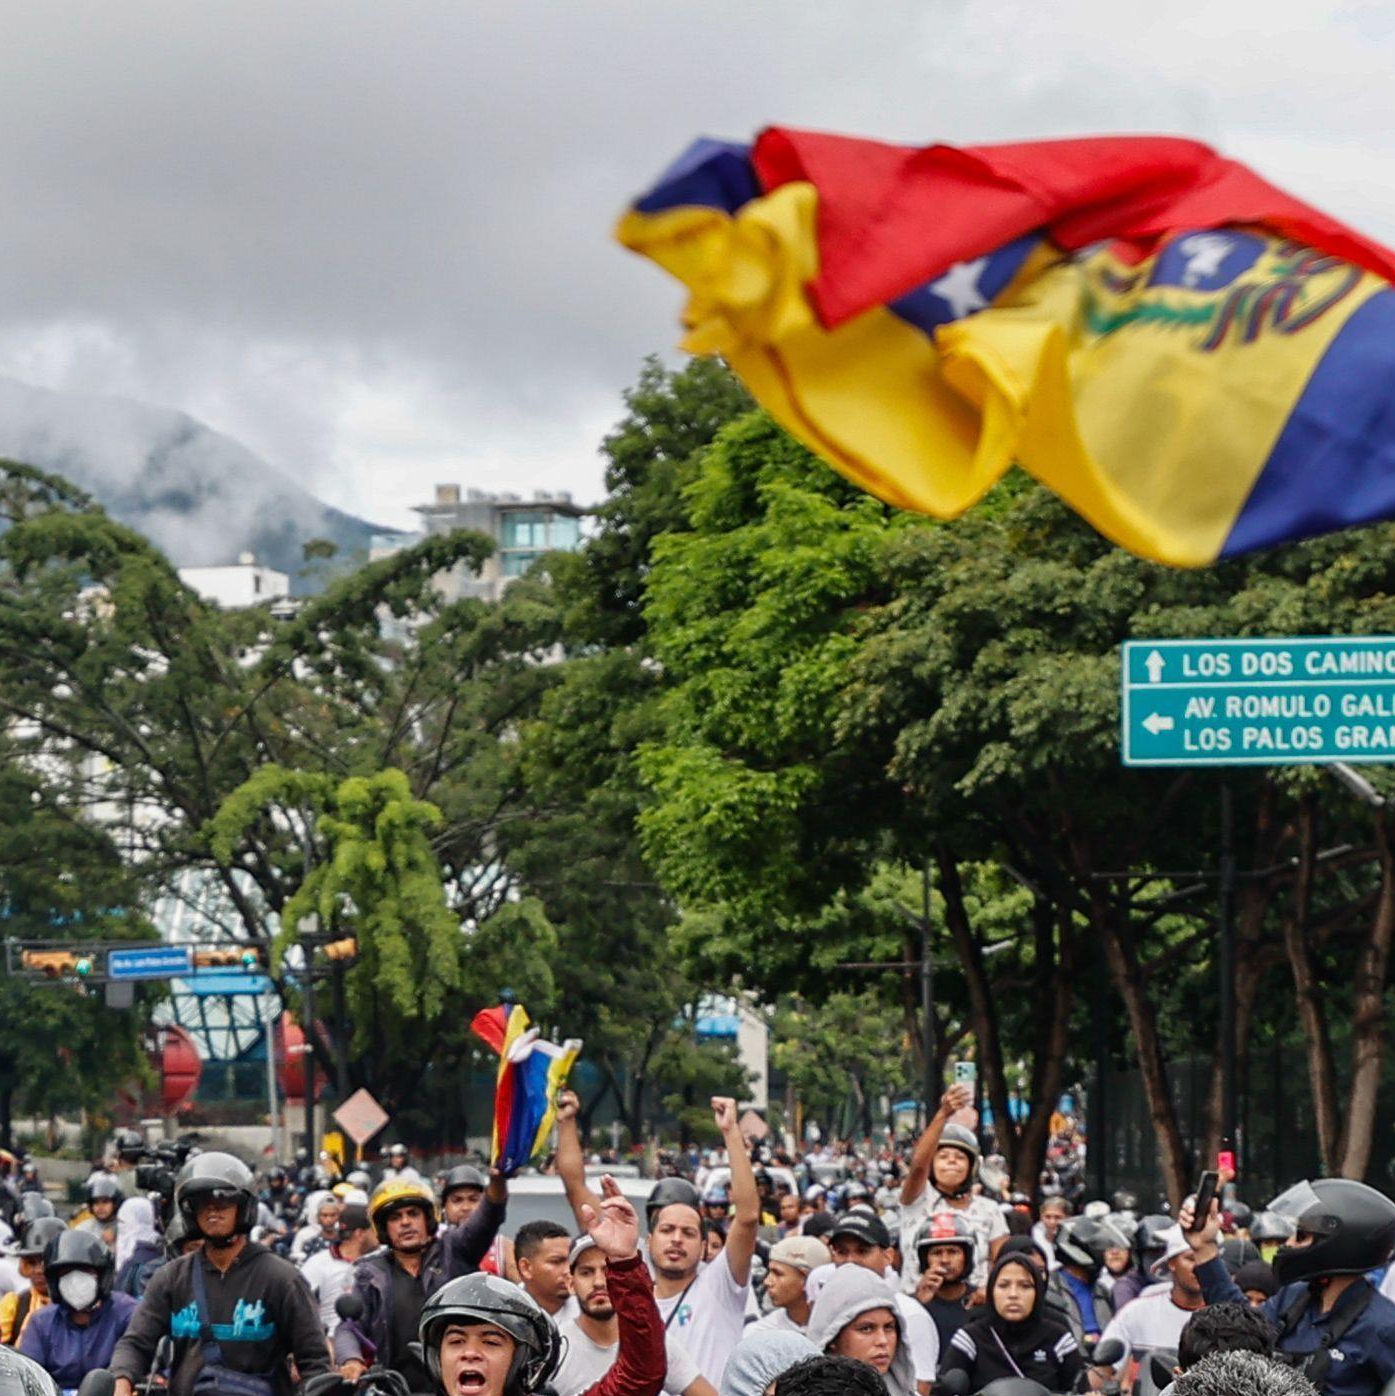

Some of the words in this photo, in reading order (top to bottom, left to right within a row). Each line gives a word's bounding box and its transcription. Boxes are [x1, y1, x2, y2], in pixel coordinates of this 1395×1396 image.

[1182, 653, 1232, 677] LOS
[1241, 651, 1294, 676] DOS
[1184, 697, 1217, 719] AV.
[1226, 693, 1331, 718] ROMULO
[1184, 727, 1232, 751] LOS
[1242, 726, 1324, 750] PALOS
